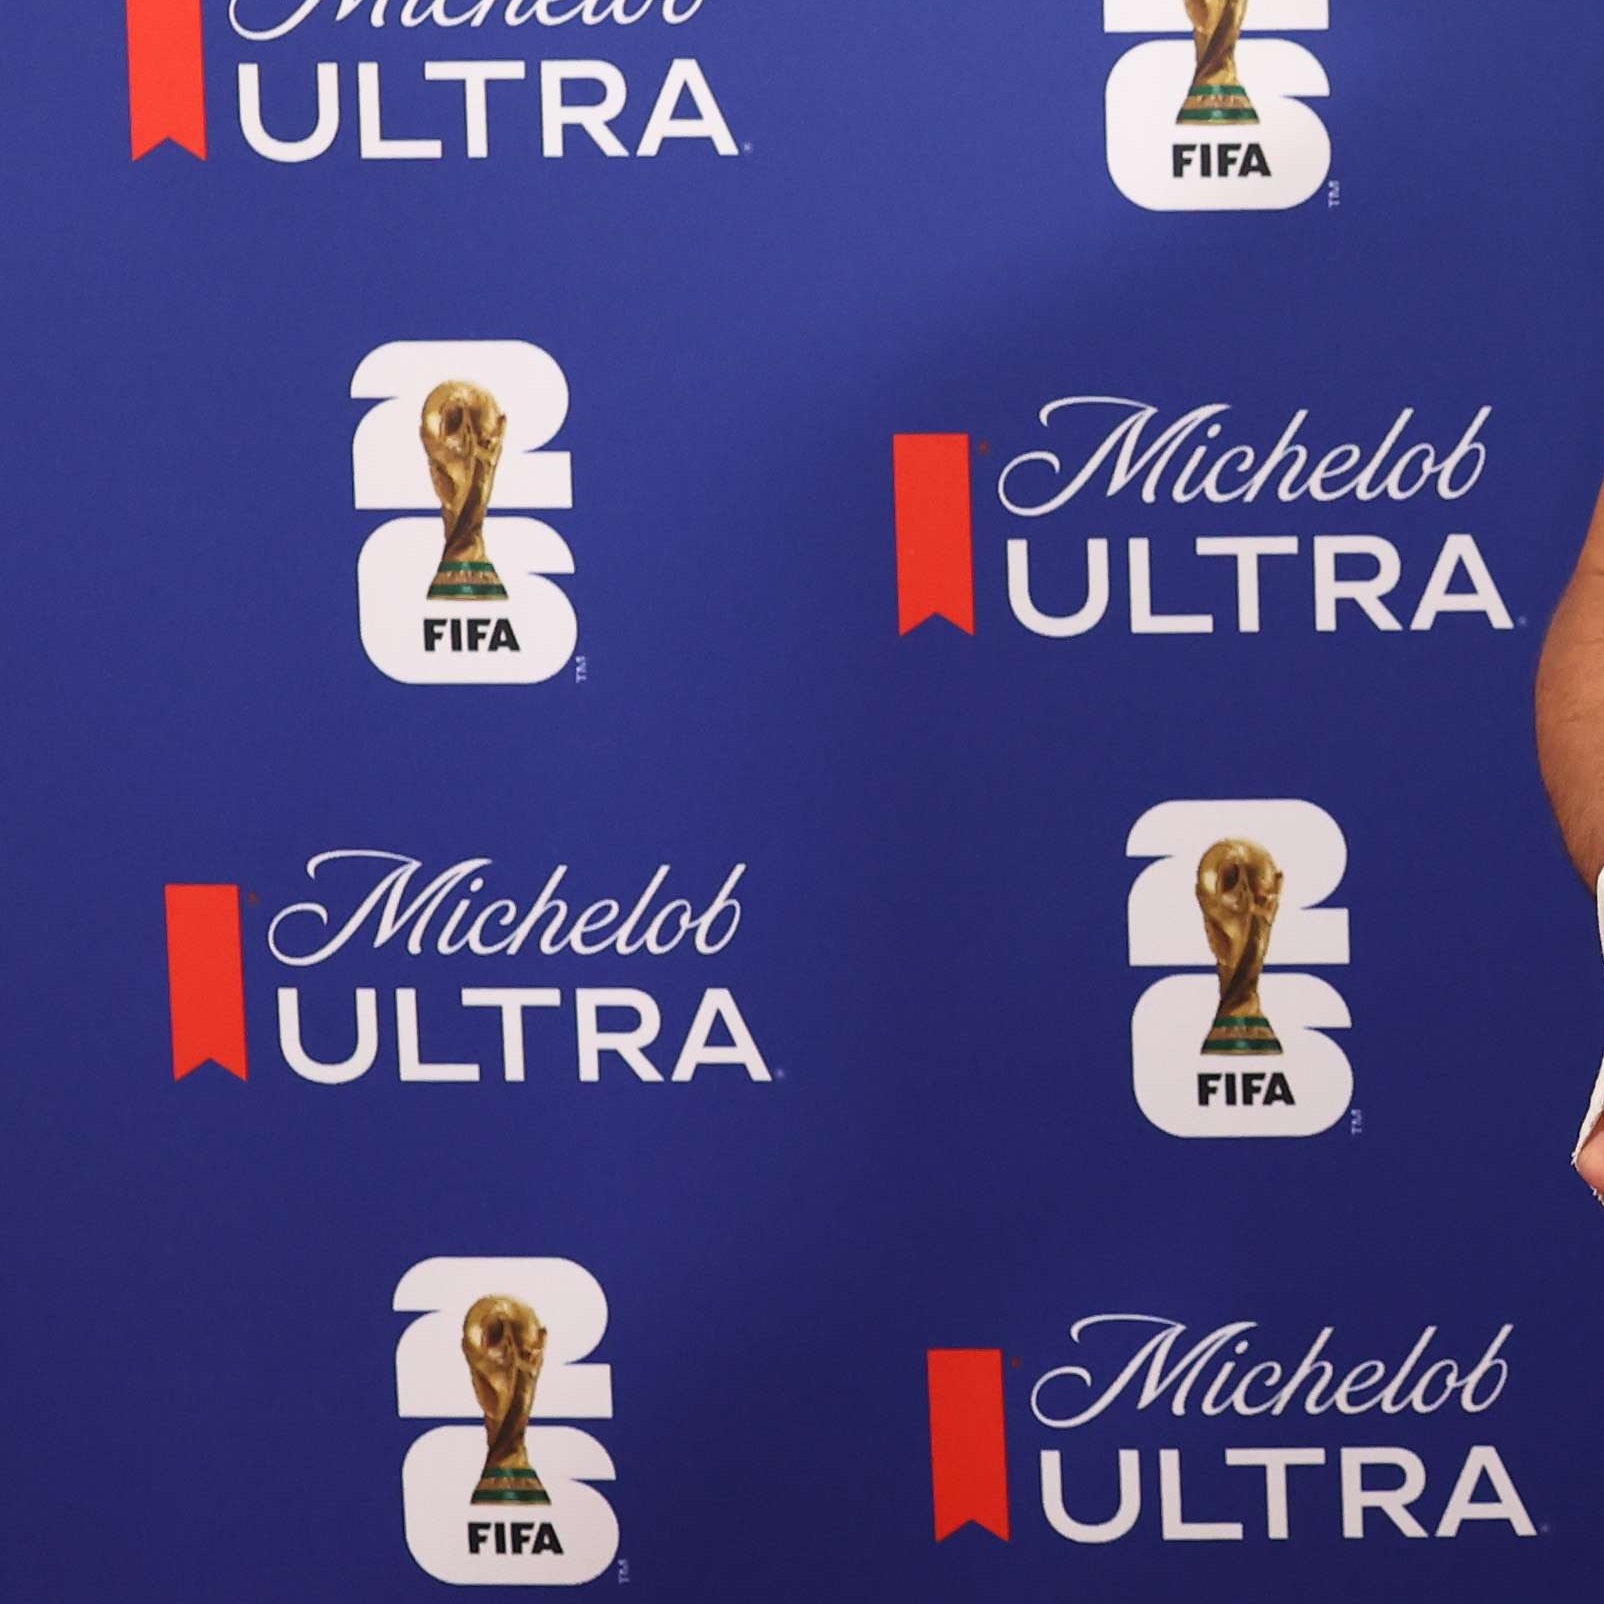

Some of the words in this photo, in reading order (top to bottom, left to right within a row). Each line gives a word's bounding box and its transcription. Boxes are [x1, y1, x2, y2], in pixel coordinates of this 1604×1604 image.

[239, 59, 738, 162] ULTRA
[1173, 143, 1271, 178] FIFA
[998, 396, 1491, 516] Michelob
[1007, 534, 1513, 637] ULTRA
[424, 618, 520, 651] FIFA
[268, 850, 745, 965] Michelob
[278, 988, 772, 1084] ULTRA
[1198, 1072, 1295, 1106] FIFA
[1031, 1314, 1513, 1428] Michelob
[468, 1522, 563, 1554] FIFA
[1041, 1446, 1536, 1543] ULTRA
